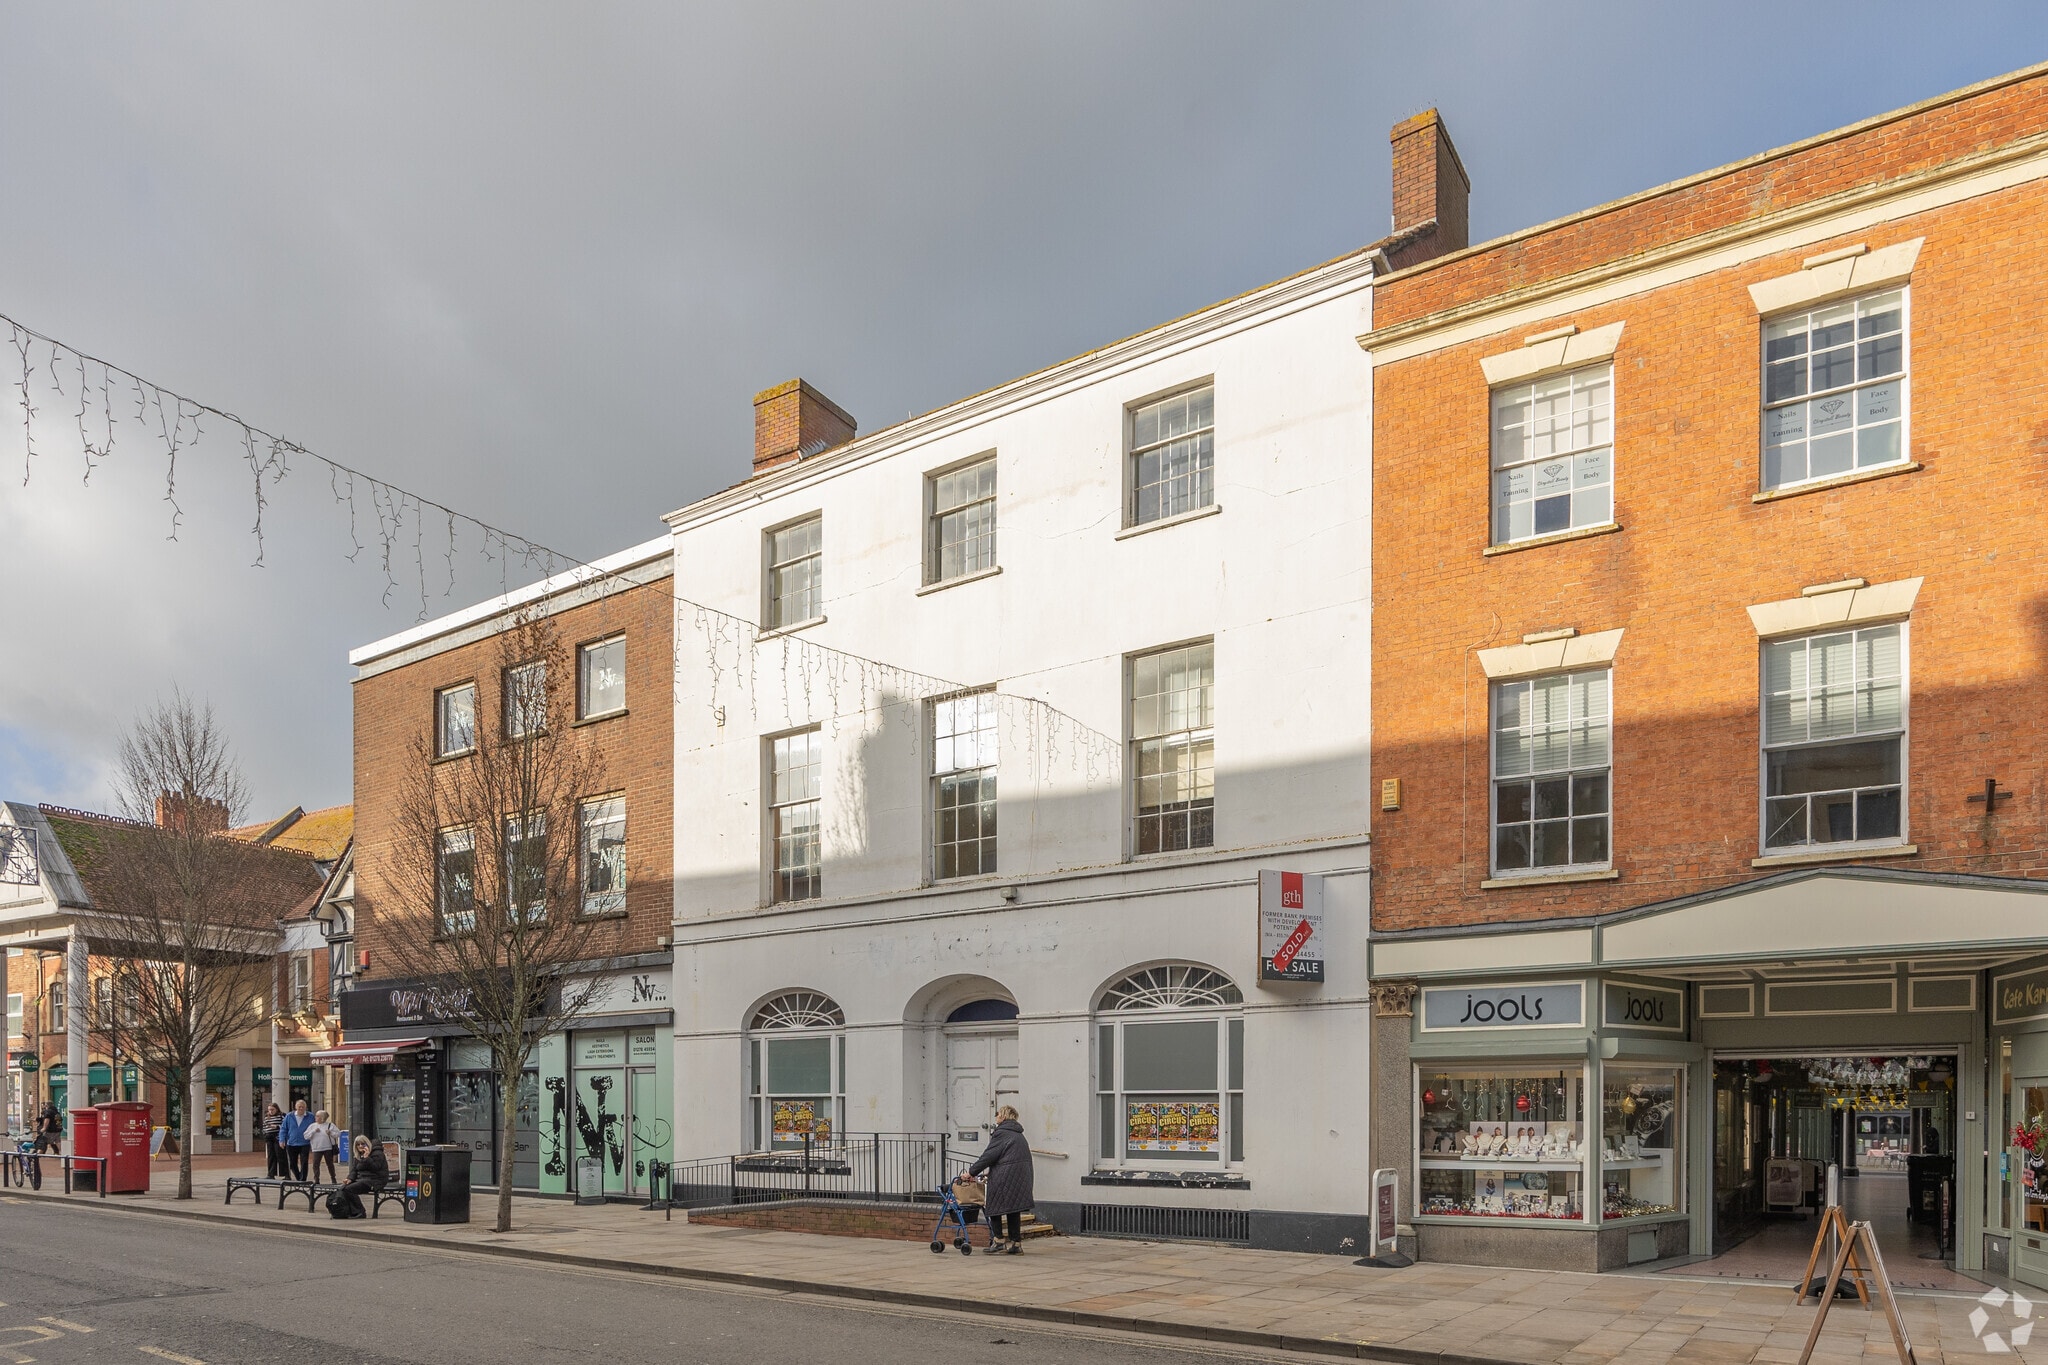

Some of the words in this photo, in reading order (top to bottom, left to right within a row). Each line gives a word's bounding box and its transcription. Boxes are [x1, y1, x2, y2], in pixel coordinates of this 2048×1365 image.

[1778, 410, 1797, 420] Nails
[1870, 405, 1889, 416] Body
[1772, 426, 1803, 438] Tanning
[1584, 470, 1600, 481] Body
[1502, 486, 1529, 498] Tanning
[1283, 889, 1302, 906] gth
[1262, 910, 1283, 918] FORMER
[1284, 912, 1298, 920] BANK
[1281, 932, 1304, 961] SOLD
[1292, 961, 1319, 974] SALE
[2003, 987, 2023, 1009] Cafe
[1460, 994, 1543, 1023] jools
[1624, 991, 1664, 1023] jools
[635, 1036, 655, 1044] SALON
[1130, 1116, 1157, 1127] CIRCUS
[1159, 1116, 1187, 1127] CIRCUS
[1189, 1116, 1218, 1127] CIRCUS
